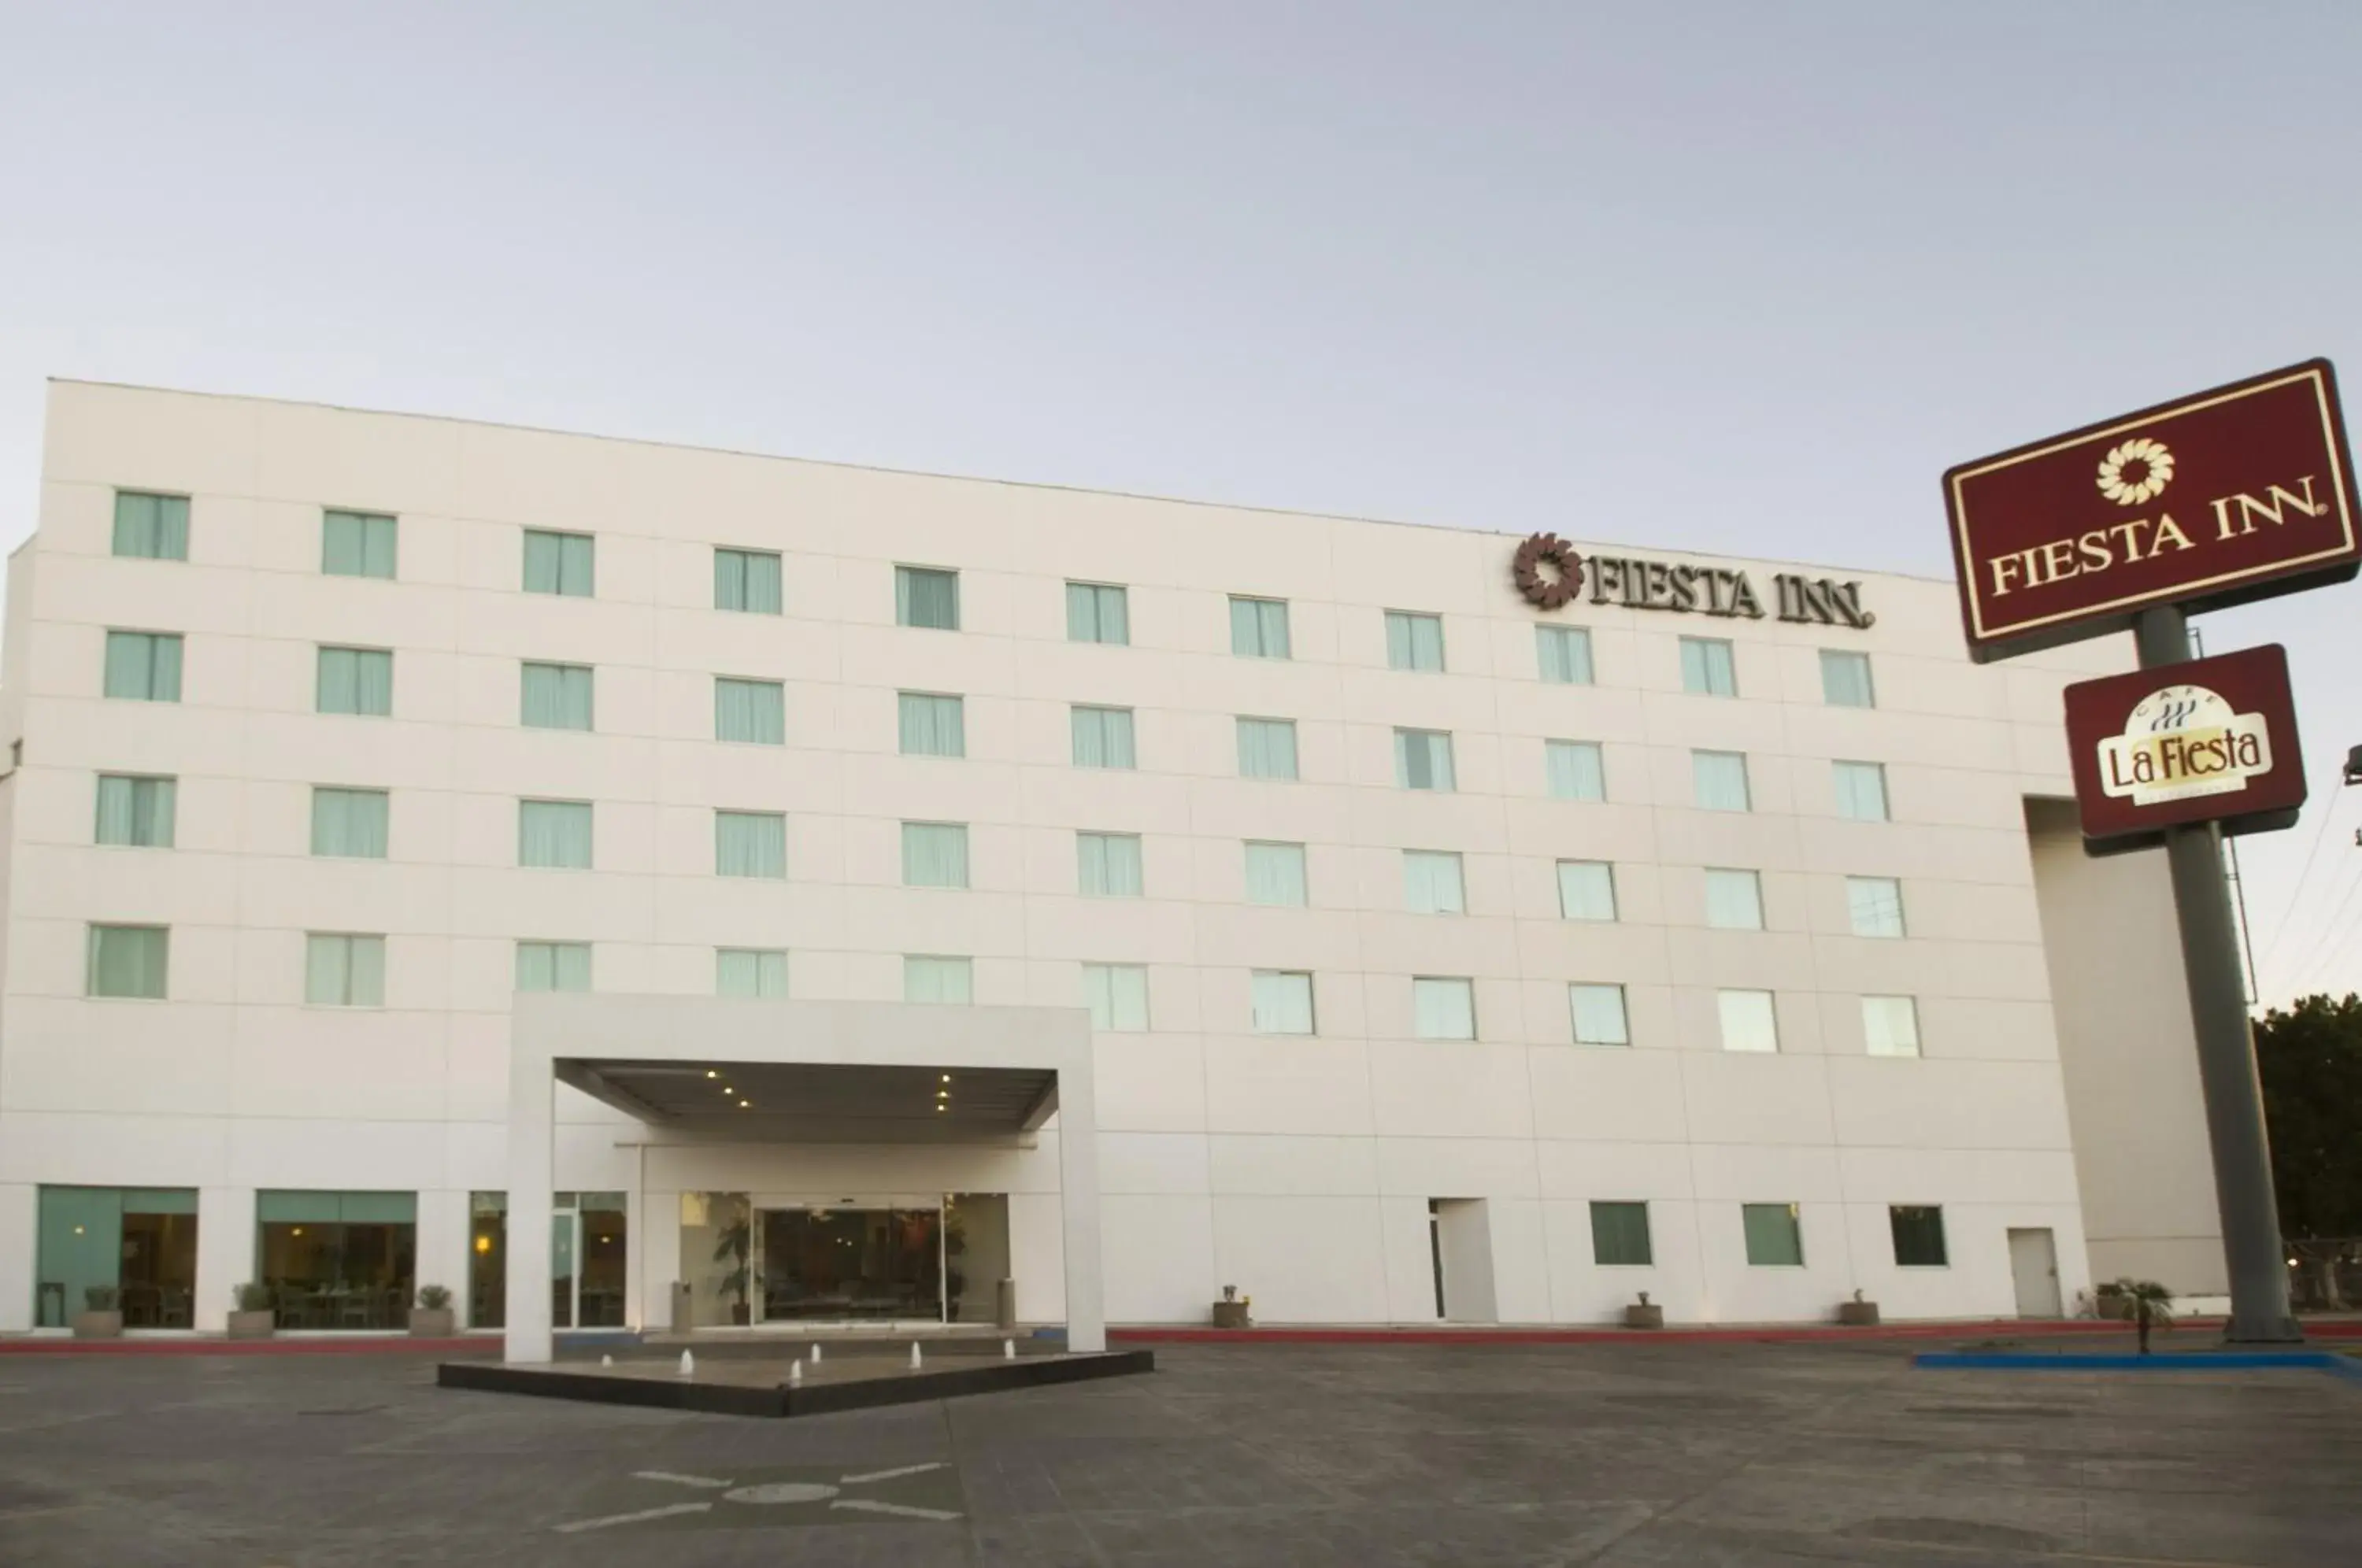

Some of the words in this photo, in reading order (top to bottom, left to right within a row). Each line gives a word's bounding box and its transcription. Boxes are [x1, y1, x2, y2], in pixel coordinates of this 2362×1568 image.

[1987, 513, 2196, 597] FIESTA
[2209, 475, 2316, 542] INN
[1588, 555, 1767, 619] FIESTA
[2109, 749, 2155, 787] La
[2160, 728, 2261, 779] Fiesta
